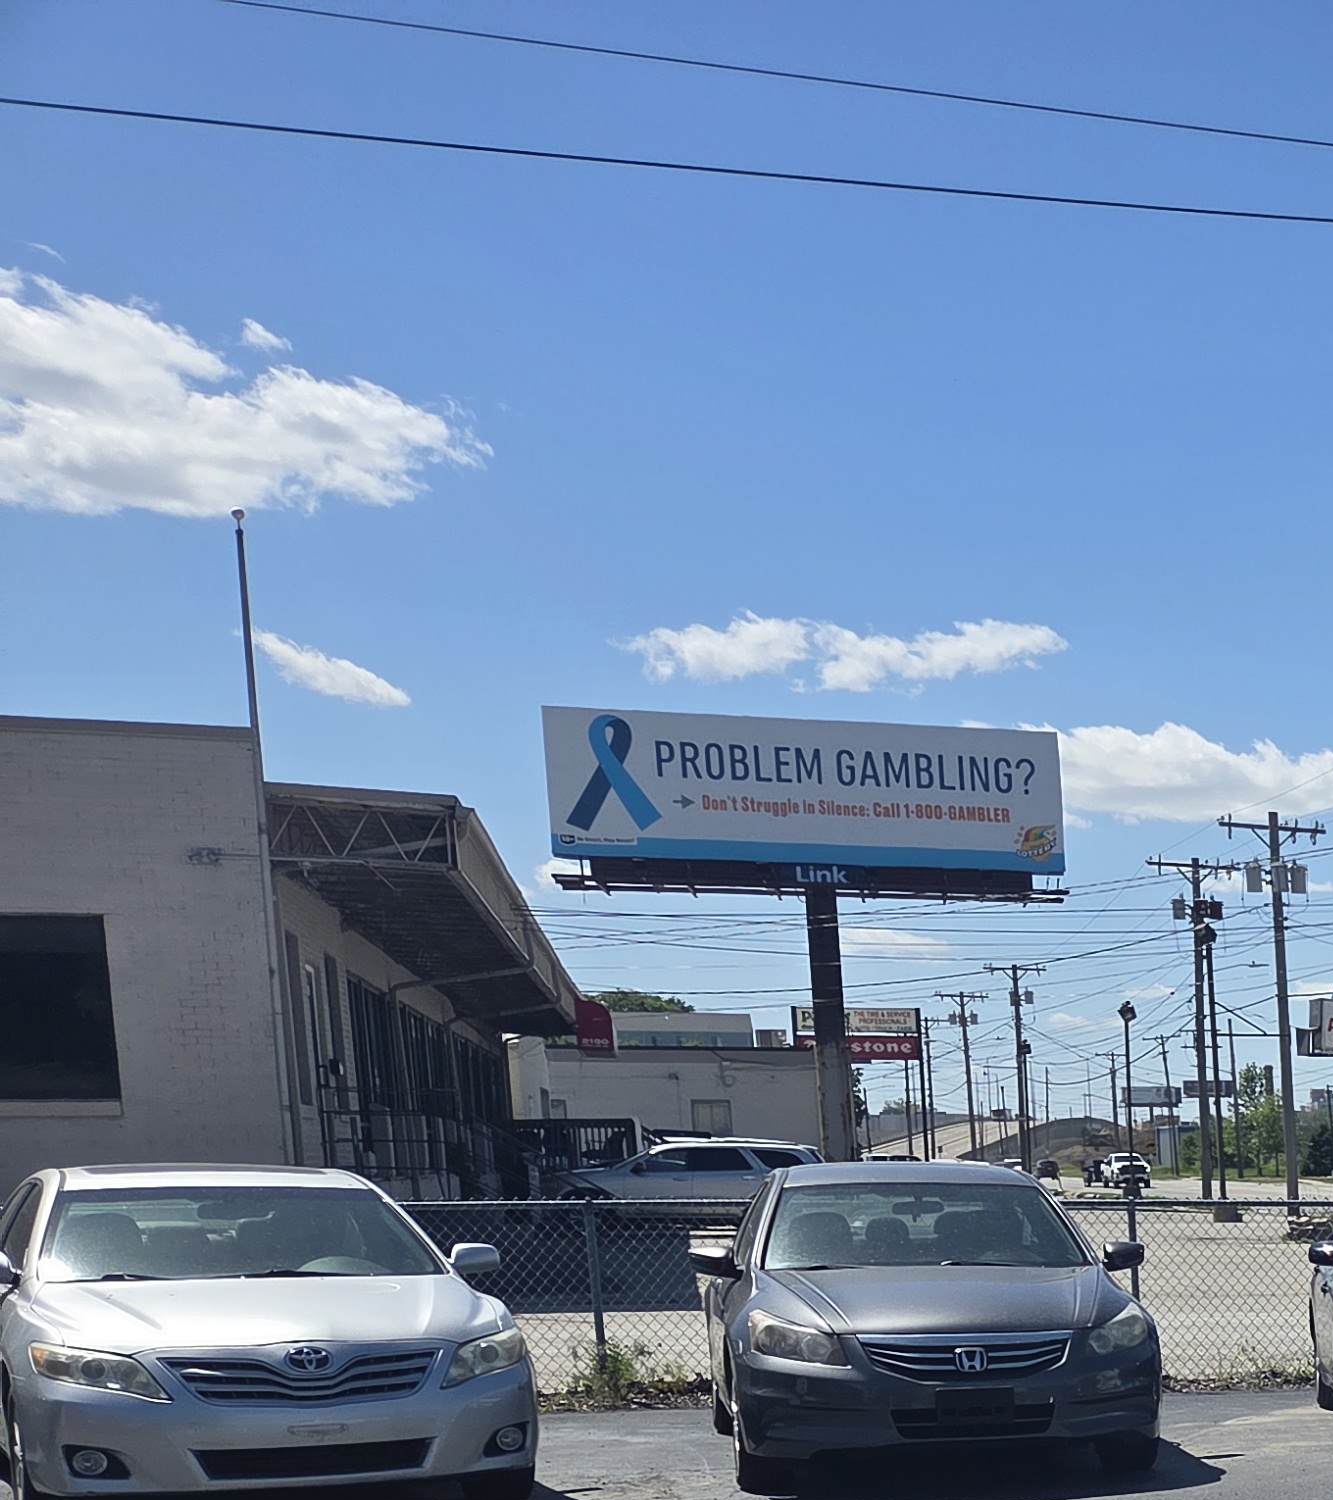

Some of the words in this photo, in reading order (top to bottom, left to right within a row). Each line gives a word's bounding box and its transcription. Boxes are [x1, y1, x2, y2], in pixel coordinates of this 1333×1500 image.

[655, 740, 823, 785] PROBLEM
[836, 749, 1036, 795] GAMBLING?
[702, 794, 739, 812] Don't
[741, 796, 800, 817] Struggle
[818, 800, 870, 818] Silence:
[873, 802, 901, 818] Call
[795, 865, 849, 883] Link
